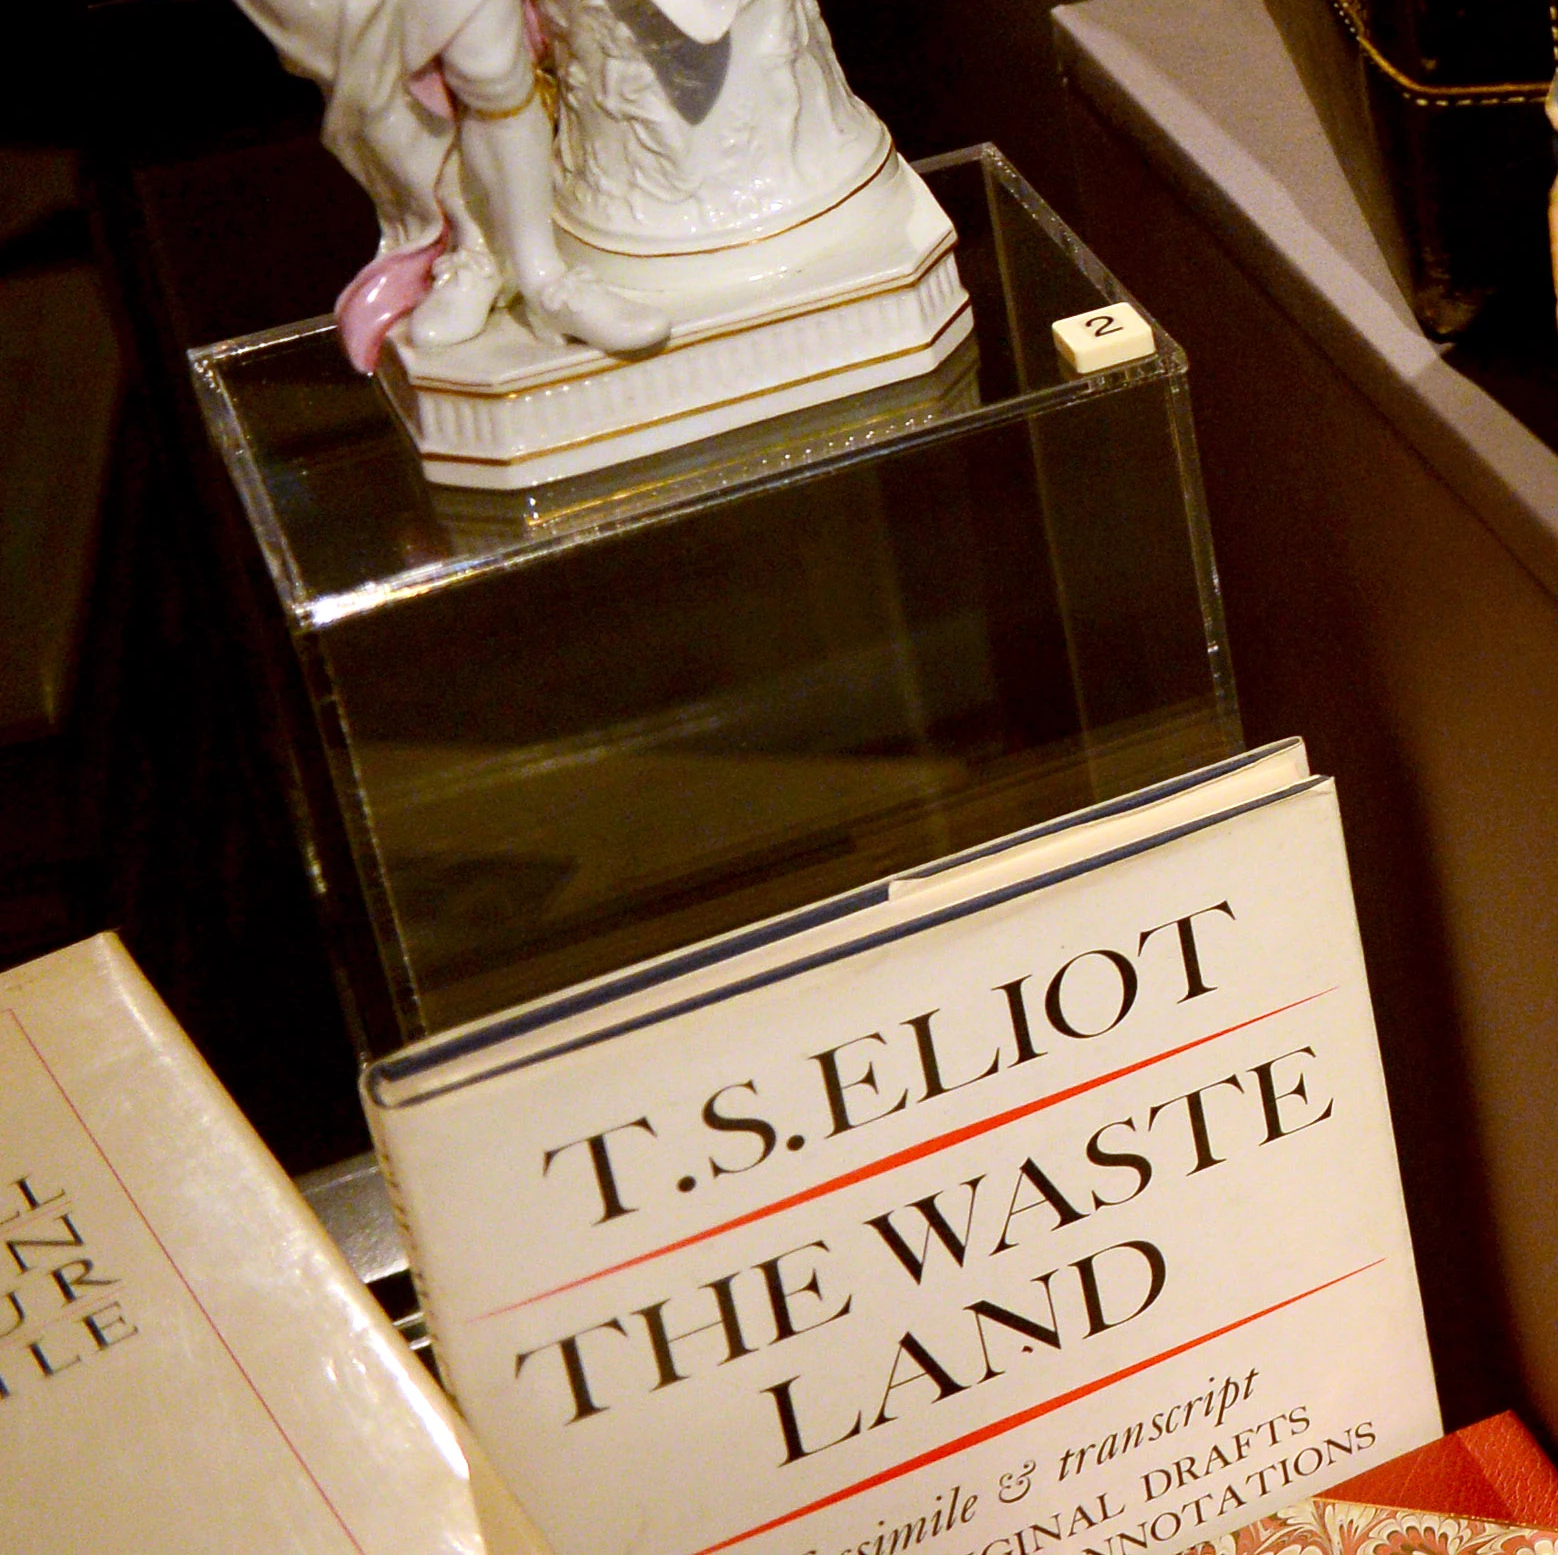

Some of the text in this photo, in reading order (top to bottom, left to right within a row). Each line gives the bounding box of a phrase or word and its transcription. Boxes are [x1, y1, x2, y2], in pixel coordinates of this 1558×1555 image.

[1085, 315, 1123, 337] 2
[514, 1047, 1334, 1426] THE WASTE
[759, 1240, 1167, 1466] LAND
[960, 1407, 1310, 1555] GINAL DRAFTS
[999, 1460, 1036, 1503] &
[1059, 1368, 1260, 1481] transcript
